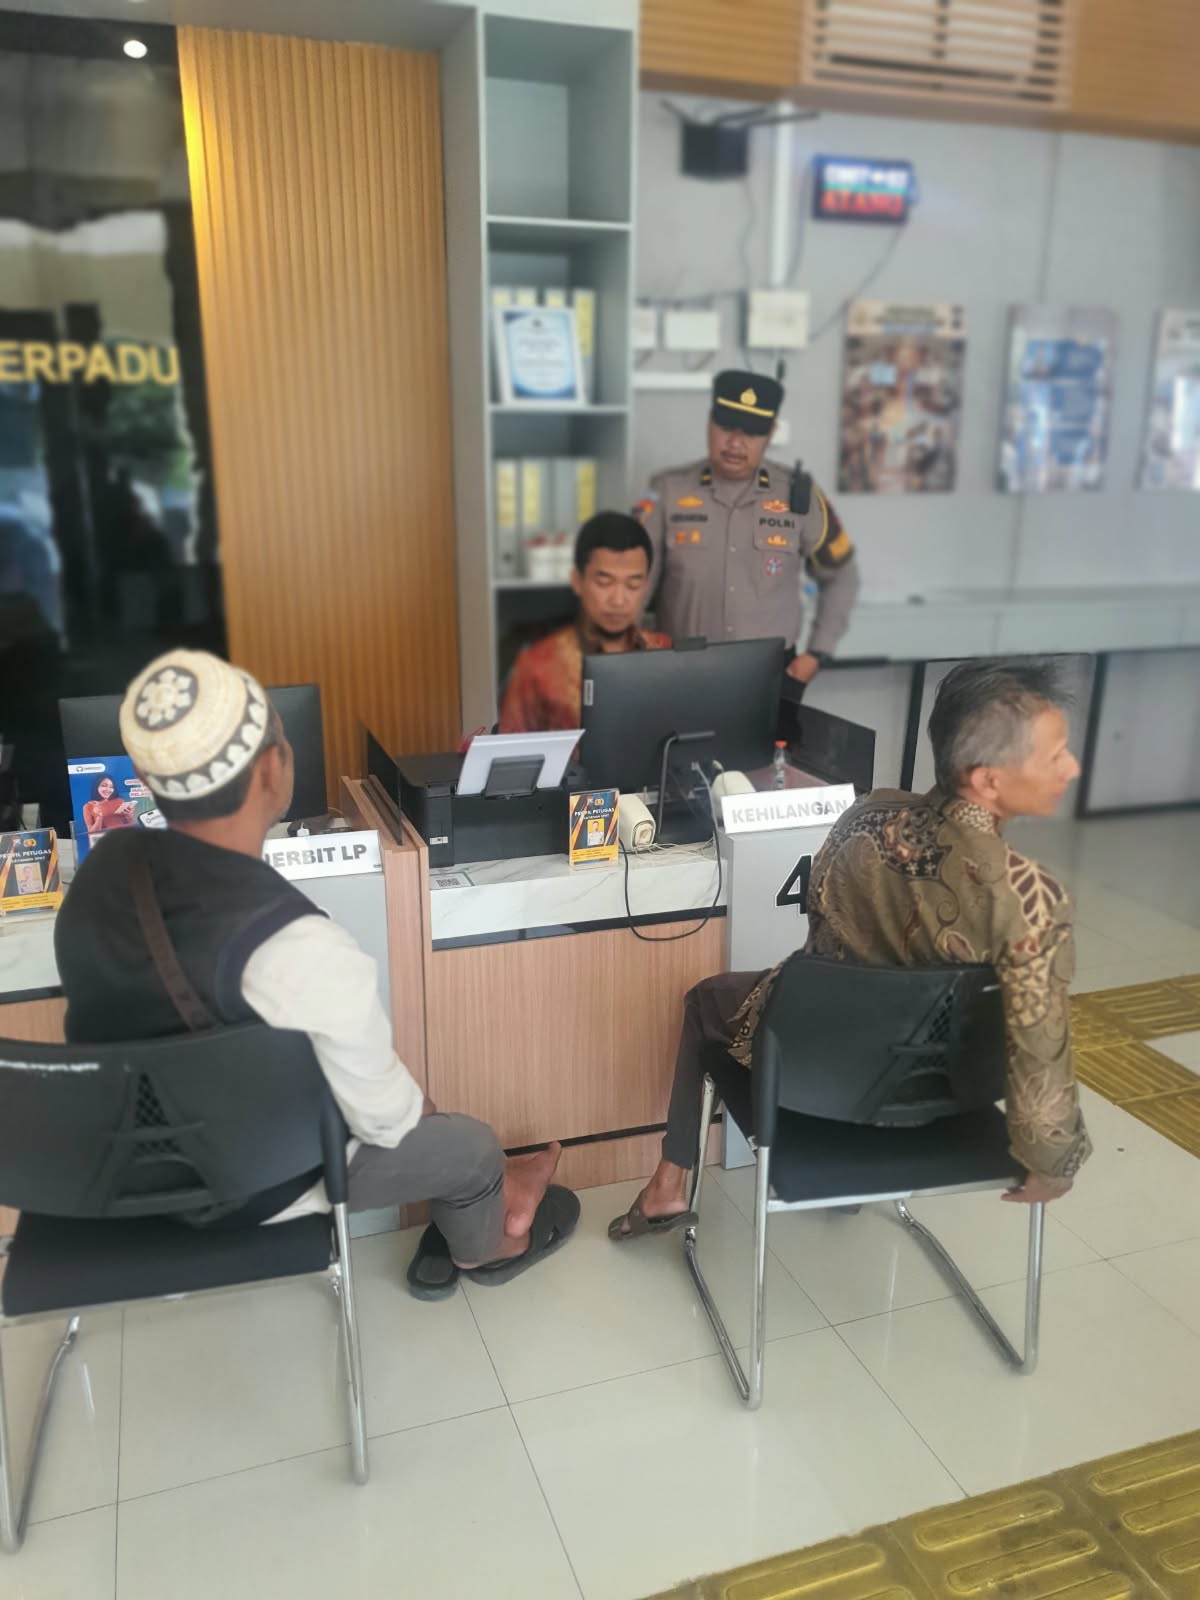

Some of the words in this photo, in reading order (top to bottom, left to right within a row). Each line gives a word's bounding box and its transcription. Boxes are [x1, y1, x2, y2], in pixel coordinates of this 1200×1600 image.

[0, 340, 181, 384] ERPADU
[759, 517, 795, 528] POLRI
[731, 799, 848, 824] KEHILANGAN
[22, 849, 51, 857] PETUGAS
[341, 844, 367, 860] LP
[775, 853, 812, 914] 4
